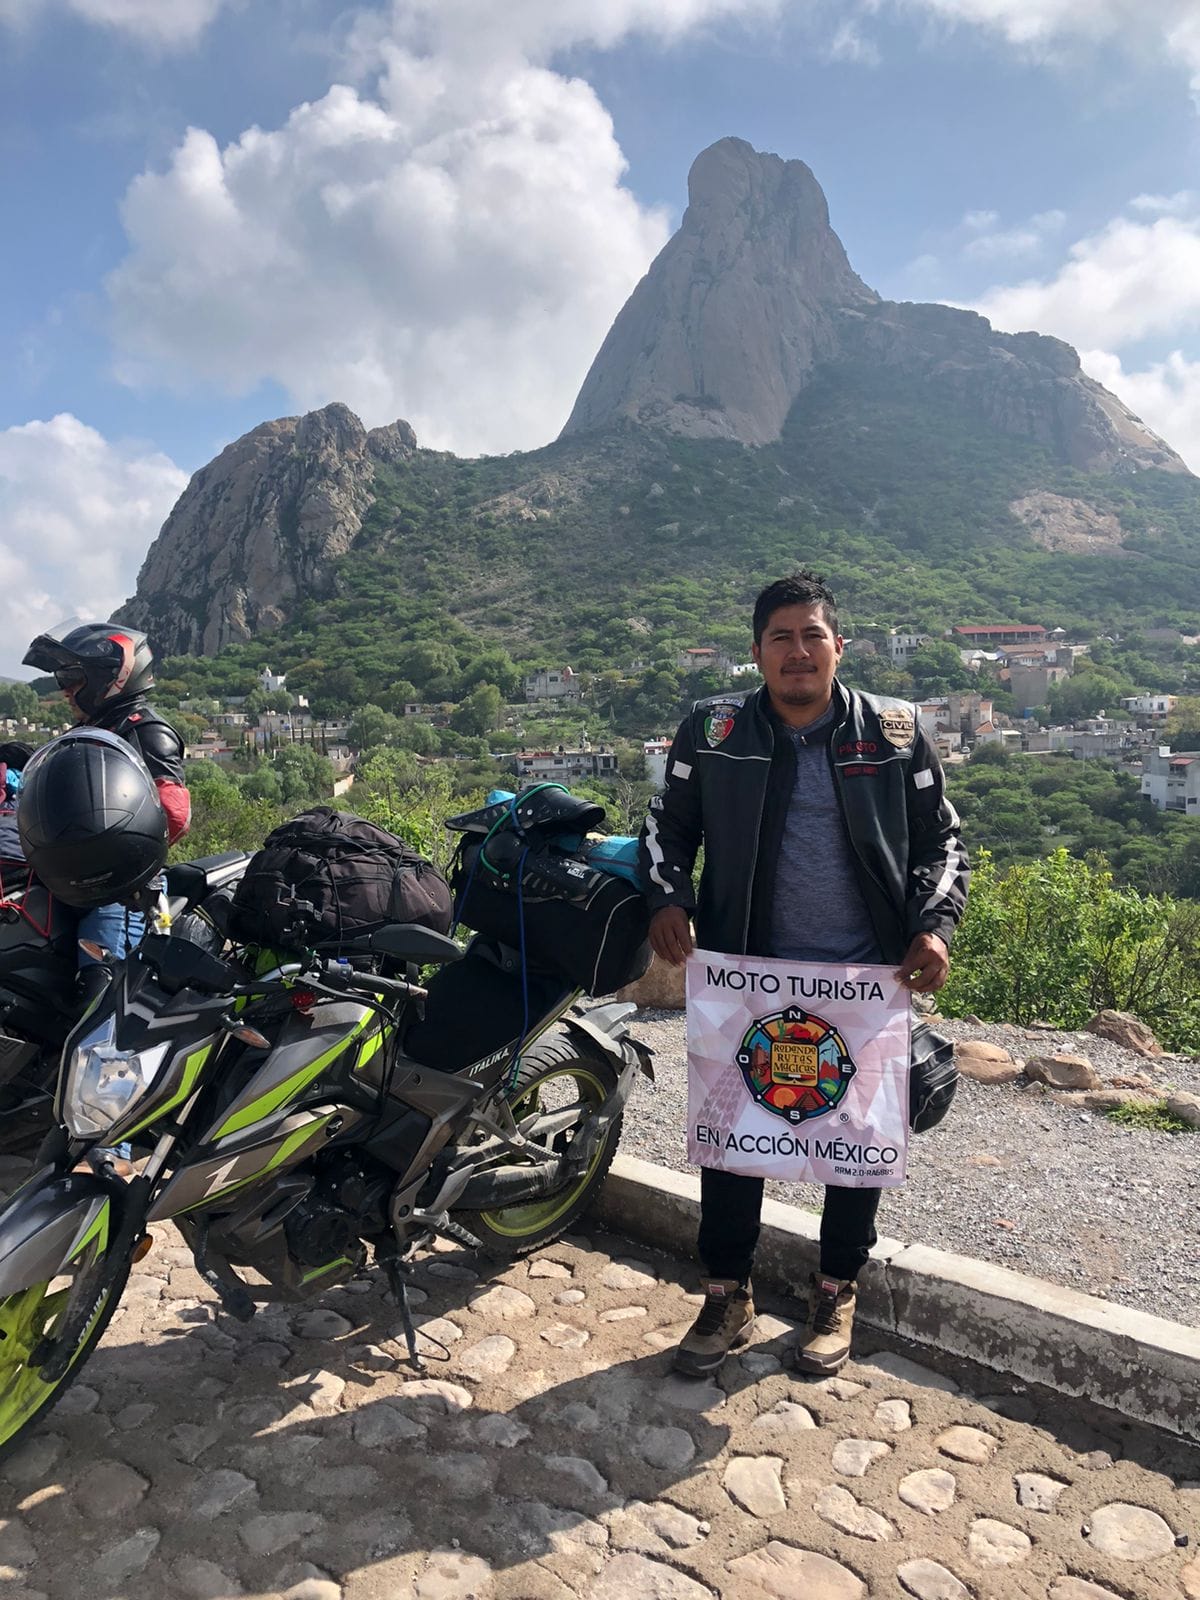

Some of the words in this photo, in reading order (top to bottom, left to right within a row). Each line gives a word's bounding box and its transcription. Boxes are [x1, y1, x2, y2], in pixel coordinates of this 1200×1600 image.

[884, 720, 913, 731] CIVIL
[706, 965, 780, 993] MOTO
[787, 976, 884, 1001] TURISTA
[789, 1010, 801, 1019] N
[469, 1047, 510, 1077] ITALIKA
[739, 1054, 749, 1063] O
[842, 1064, 852, 1074] E
[789, 1110, 801, 1120] S
[696, 1125, 720, 1147] EN
[725, 1132, 809, 1157] ACCIÓN
[815, 1137, 898, 1164] MÉXICO
